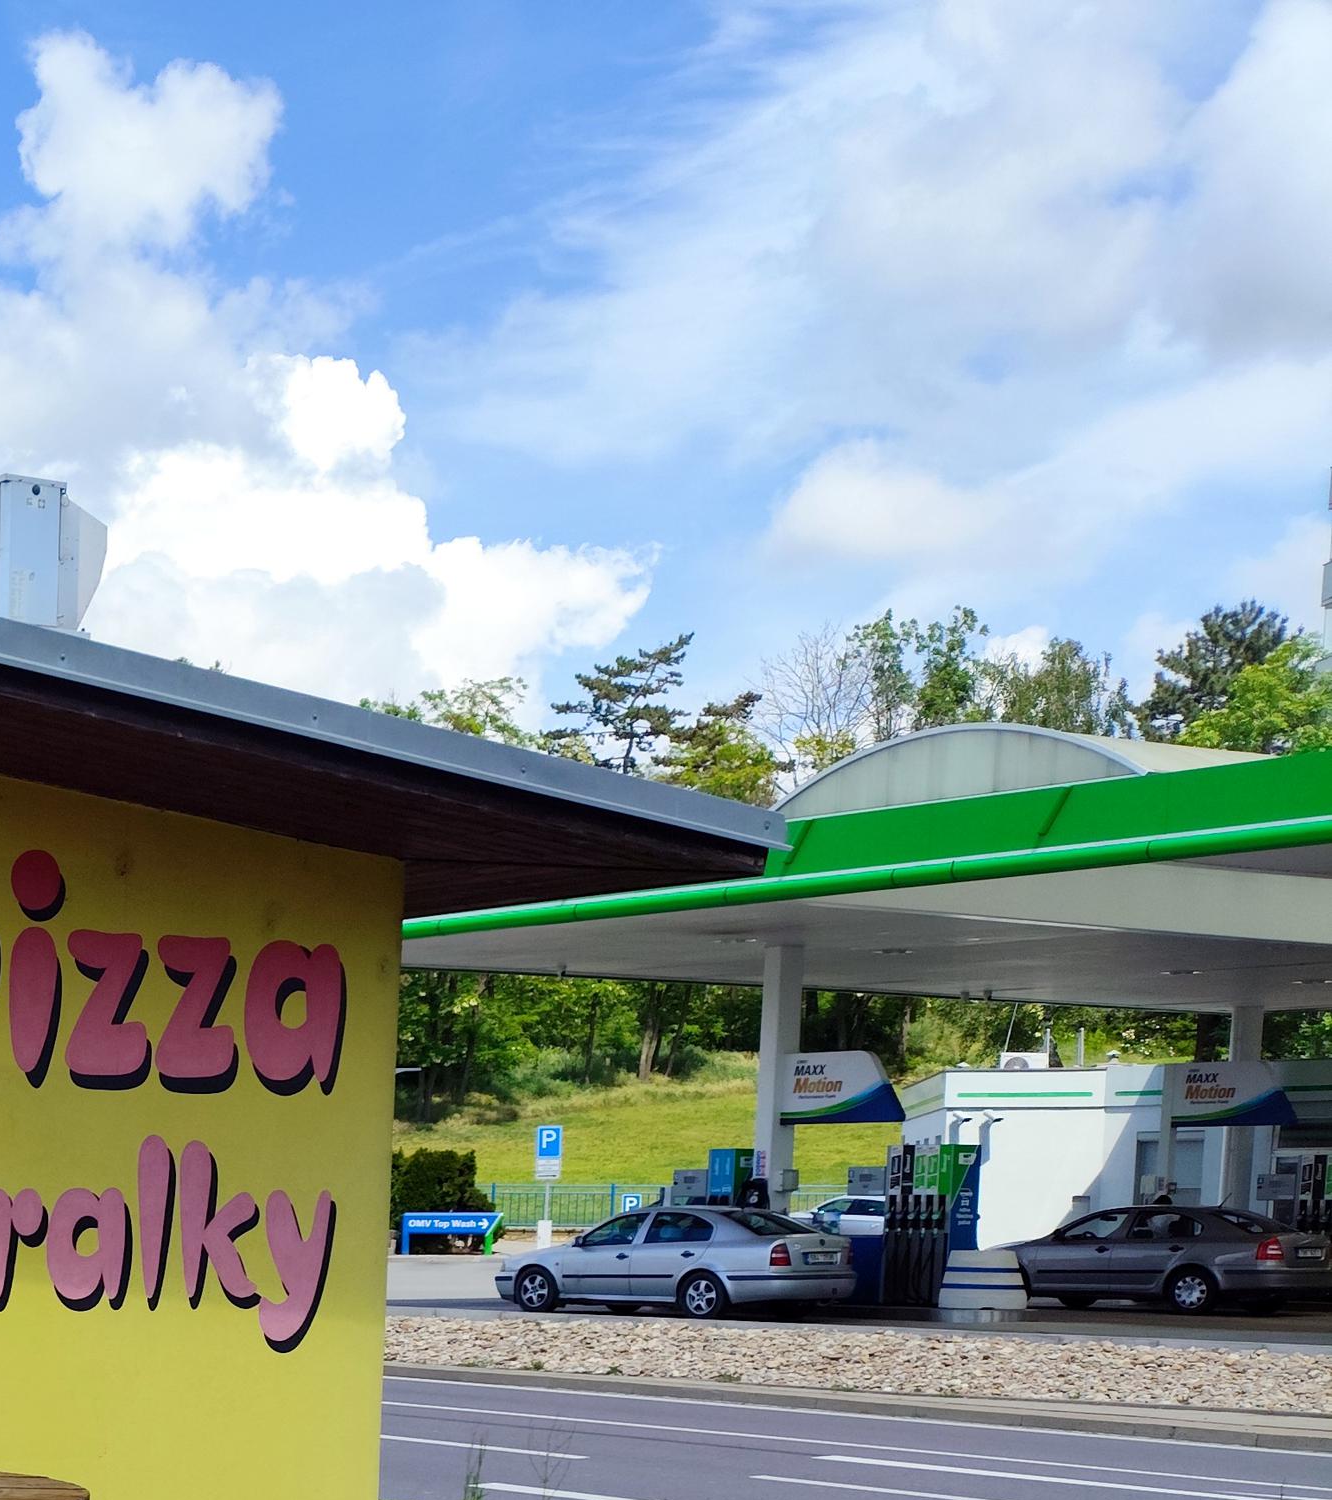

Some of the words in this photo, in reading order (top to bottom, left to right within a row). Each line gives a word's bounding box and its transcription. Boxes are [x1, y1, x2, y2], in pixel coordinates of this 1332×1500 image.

[794, 1064, 827, 1076] MAXX
[793, 1077, 843, 1094] Motion
[1185, 1073, 1219, 1084] MAXX
[1184, 1084, 1236, 1100] Motion
[542, 1129, 557, 1149] P
[408, 1219, 432, 1228] OMV
[433, 1219, 450, 1229] Top
[451, 1219, 477, 1228] Wash
